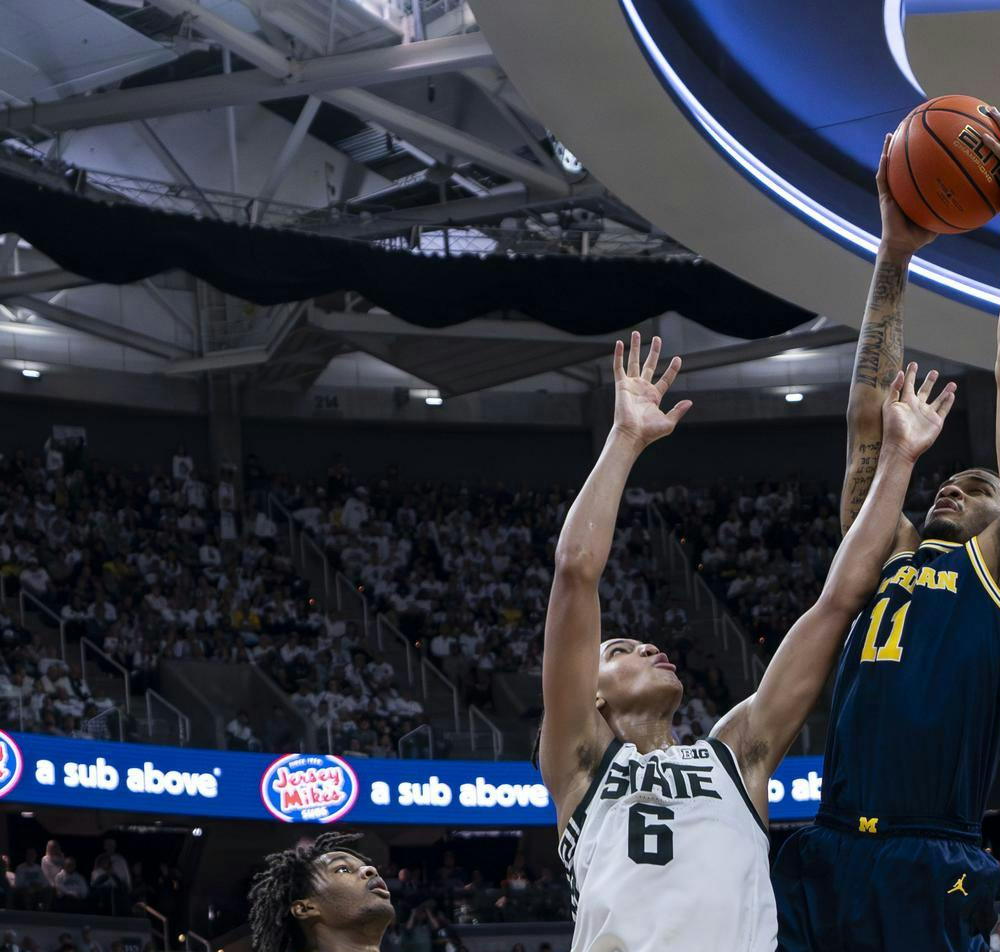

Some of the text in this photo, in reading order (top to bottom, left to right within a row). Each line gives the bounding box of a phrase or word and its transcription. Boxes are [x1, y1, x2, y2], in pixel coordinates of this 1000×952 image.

[861, 597, 912, 664] 11
[35, 759, 55, 785] a
[63, 757, 119, 791] sub
[273, 767, 344, 792] Jersey
[600, 755, 723, 800] STATE
[370, 776, 549, 808] a sub above
[628, 803, 674, 866] 6
[859, 816, 879, 833] M
